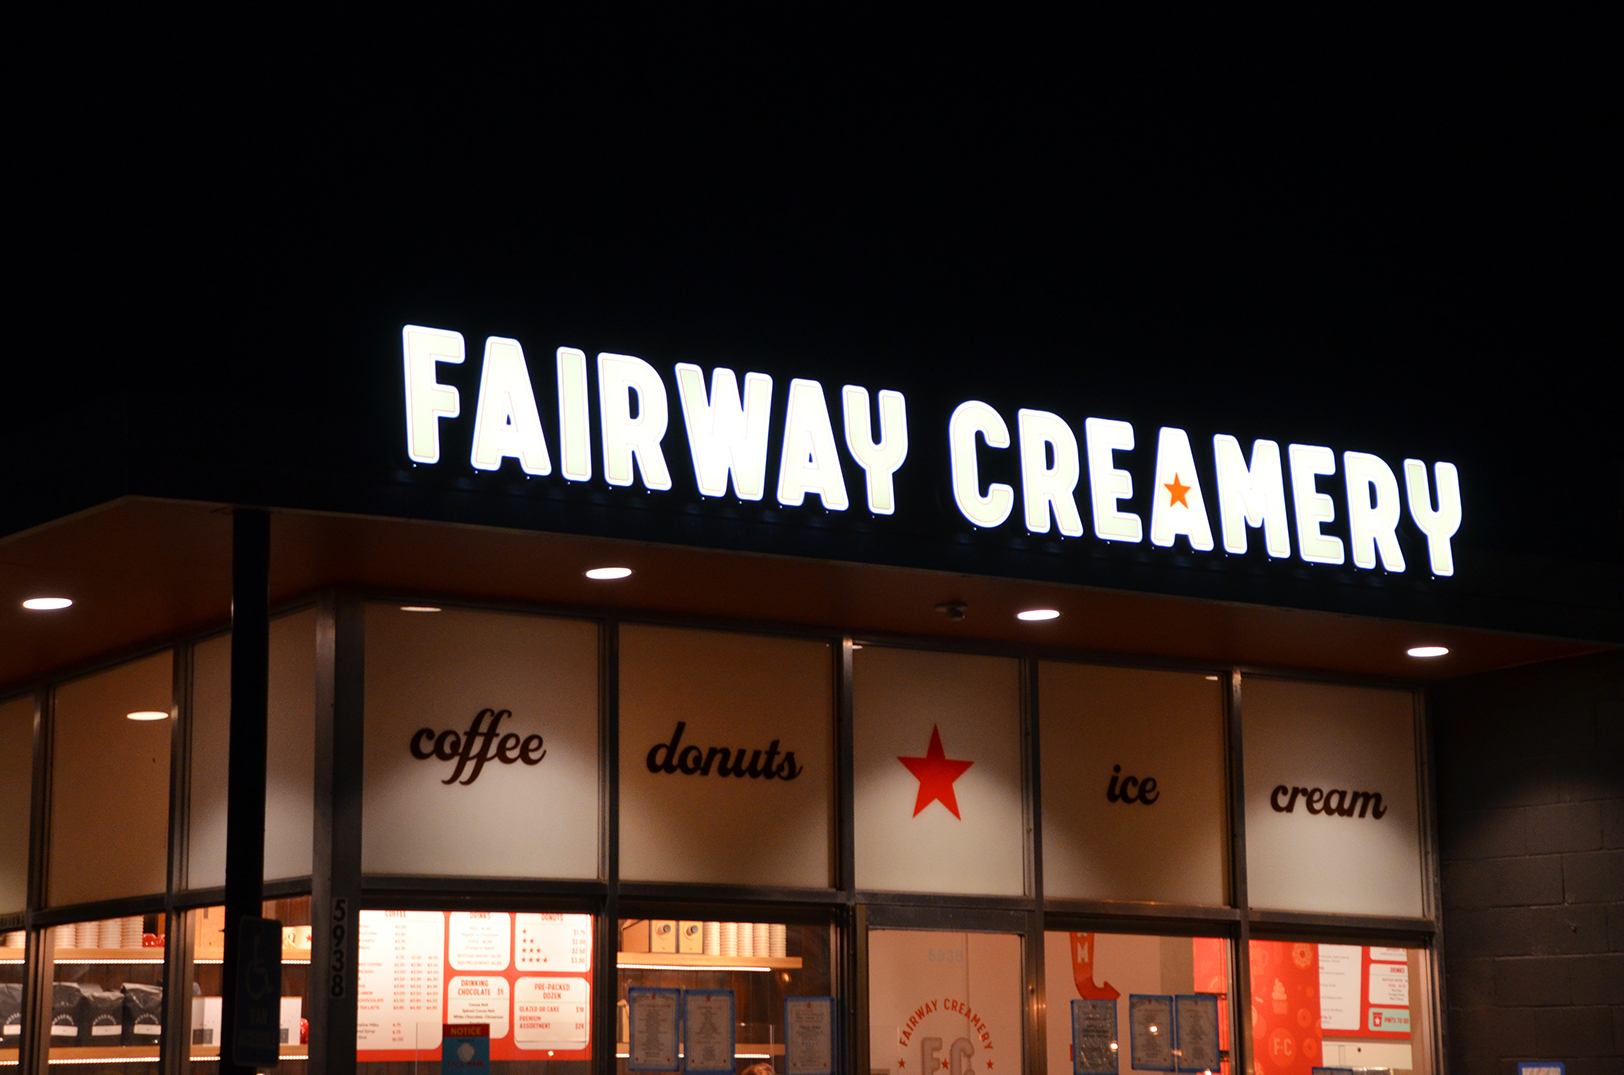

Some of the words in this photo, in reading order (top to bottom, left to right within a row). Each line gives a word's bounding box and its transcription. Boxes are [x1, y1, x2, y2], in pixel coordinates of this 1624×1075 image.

[402, 324, 908, 515] FAIRWAY
[949, 400, 1462, 577] CREAMERY
[409, 708, 547, 786] coffee
[646, 721, 803, 781] donuts
[1106, 764, 1160, 805] ice
[1270, 784, 1387, 820] cream
[541, 913, 564, 921] DONUTS
[331, 899, 346, 998] 5938
[457, 988, 491, 996] CHOCOLATE
[461, 979, 489, 987] DRINKING
[534, 983, 570, 991] PRE-PACKED
[450, 1026, 482, 1036] NOTICE
[899, 999, 938, 1047] FAIRWAY
[943, 998, 994, 1050] CREAMERY
